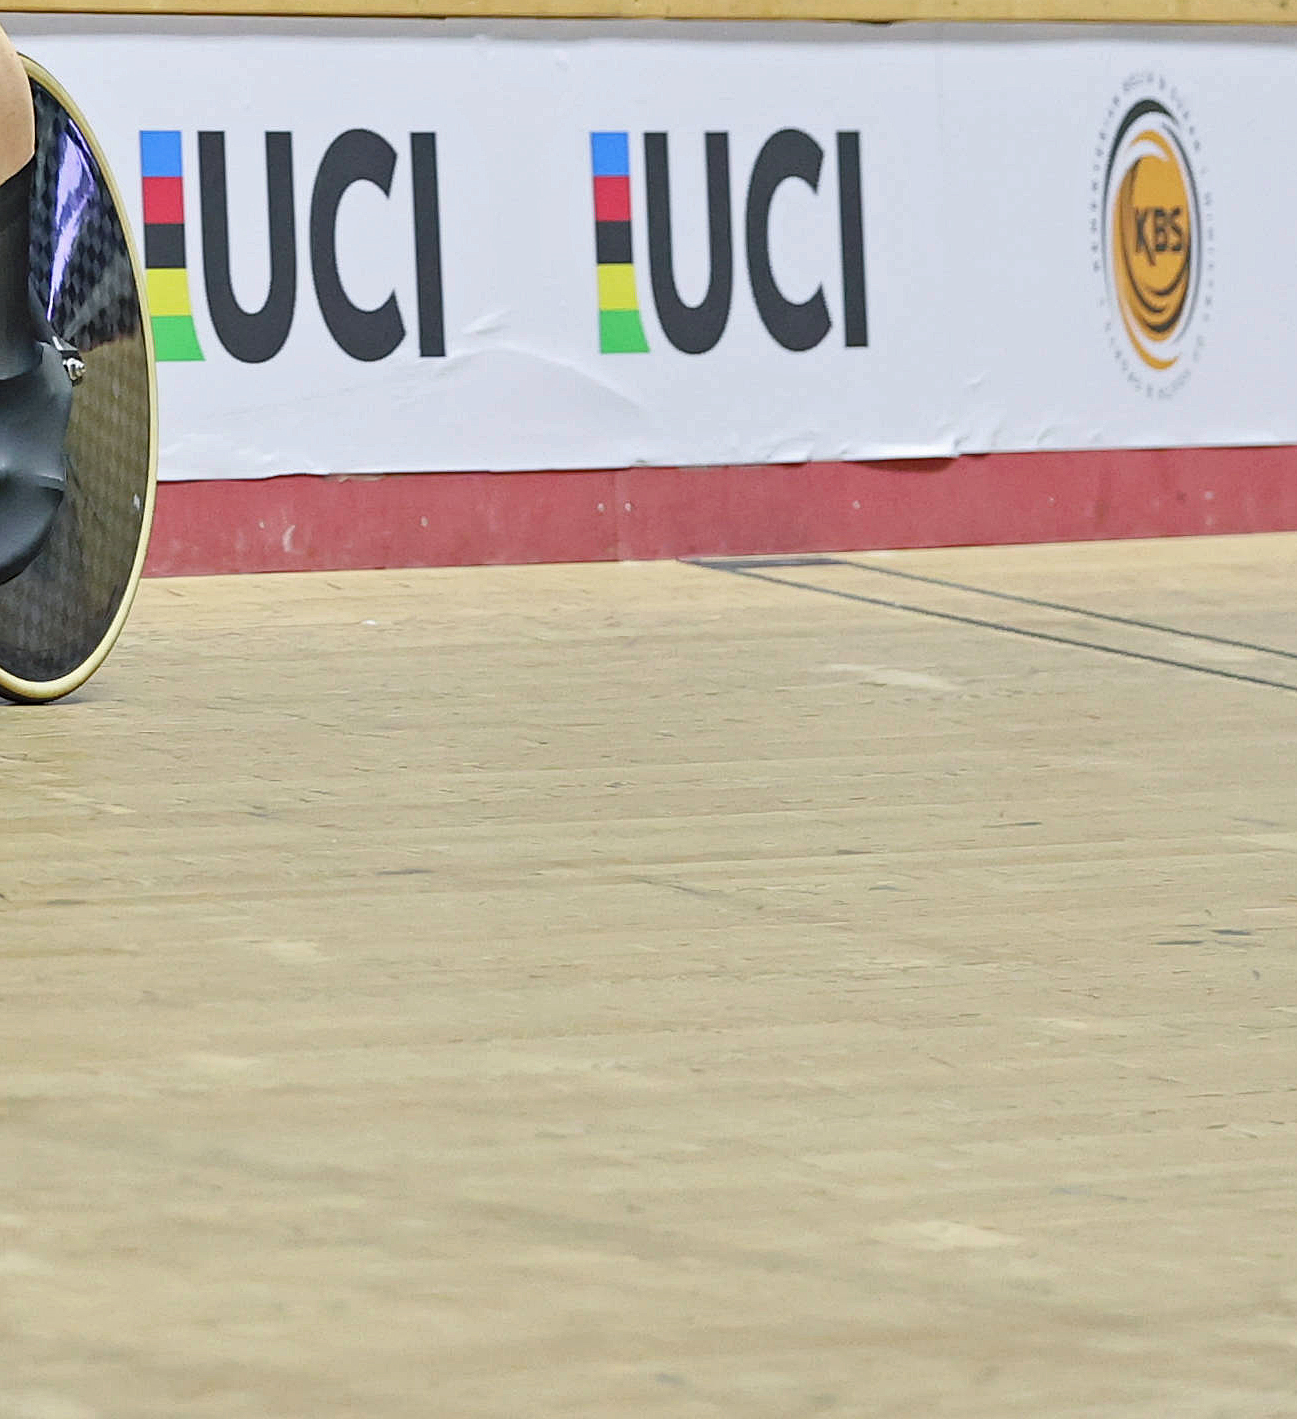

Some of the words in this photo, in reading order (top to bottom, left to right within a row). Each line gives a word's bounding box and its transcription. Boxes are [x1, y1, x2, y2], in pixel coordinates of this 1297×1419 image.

[197, 128, 446, 364] UCI
[643, 128, 869, 355] UCI
[1134, 207, 1185, 268] KBS
